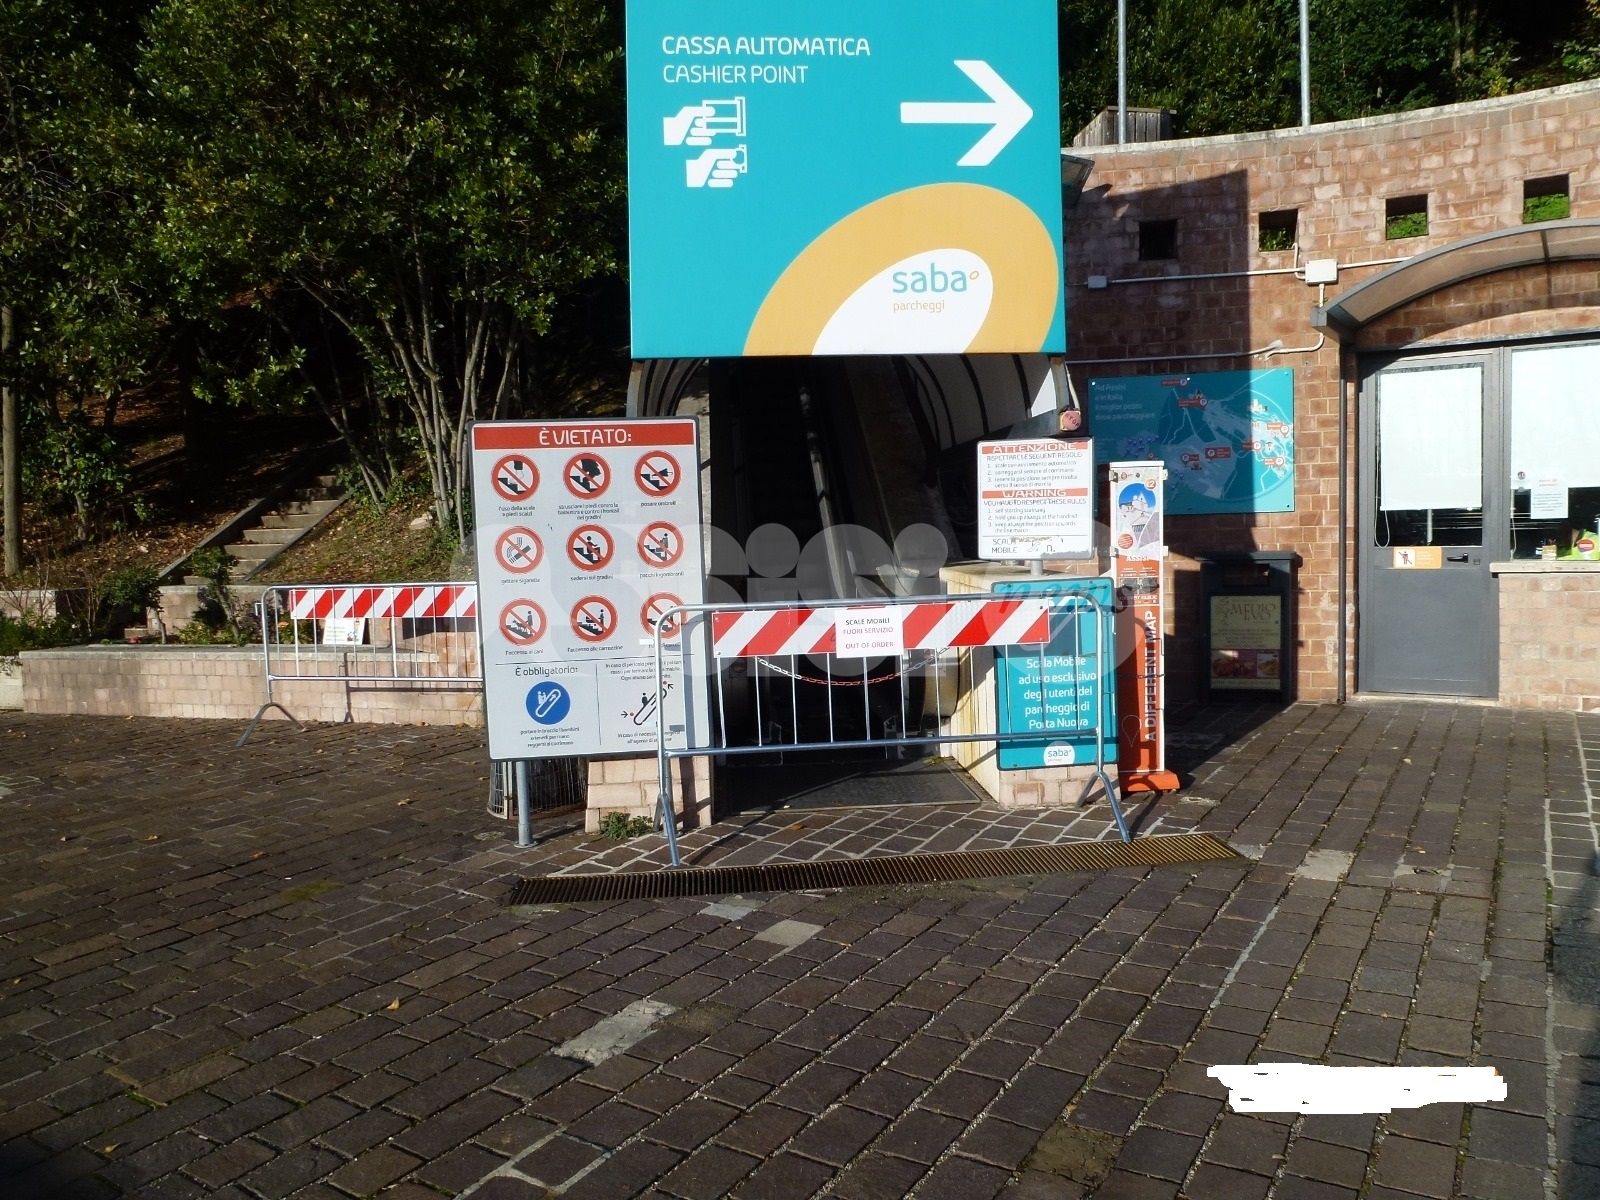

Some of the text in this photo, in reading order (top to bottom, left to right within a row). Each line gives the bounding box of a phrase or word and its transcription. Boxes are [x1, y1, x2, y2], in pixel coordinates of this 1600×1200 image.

[662, 36, 870, 56] CASSA AUTOMATICA
[663, 65, 809, 84] CASHIER POINT
[892, 263, 968, 294] saba
[892, 300, 945, 313] parcheggi
[540, 427, 632, 446] È VIETATO:
[992, 442, 1077, 453] ATTENZIONE
[1002, 489, 1066, 498] WARNING
[1145, 610, 1156, 643] MAP
[1026, 656, 1086, 668] Scla Moble
[516, 666, 578, 677] È obbligatorio:
[1019, 674, 1030, 684] ad
[1052, 671, 1096, 682] esclusivo
[1024, 686, 1092, 701] degi utenti del
[1145, 647, 1156, 728] DIFFERENT
[1025, 701, 1090, 717] parheggio di
[1048, 748, 1068, 757] saba
